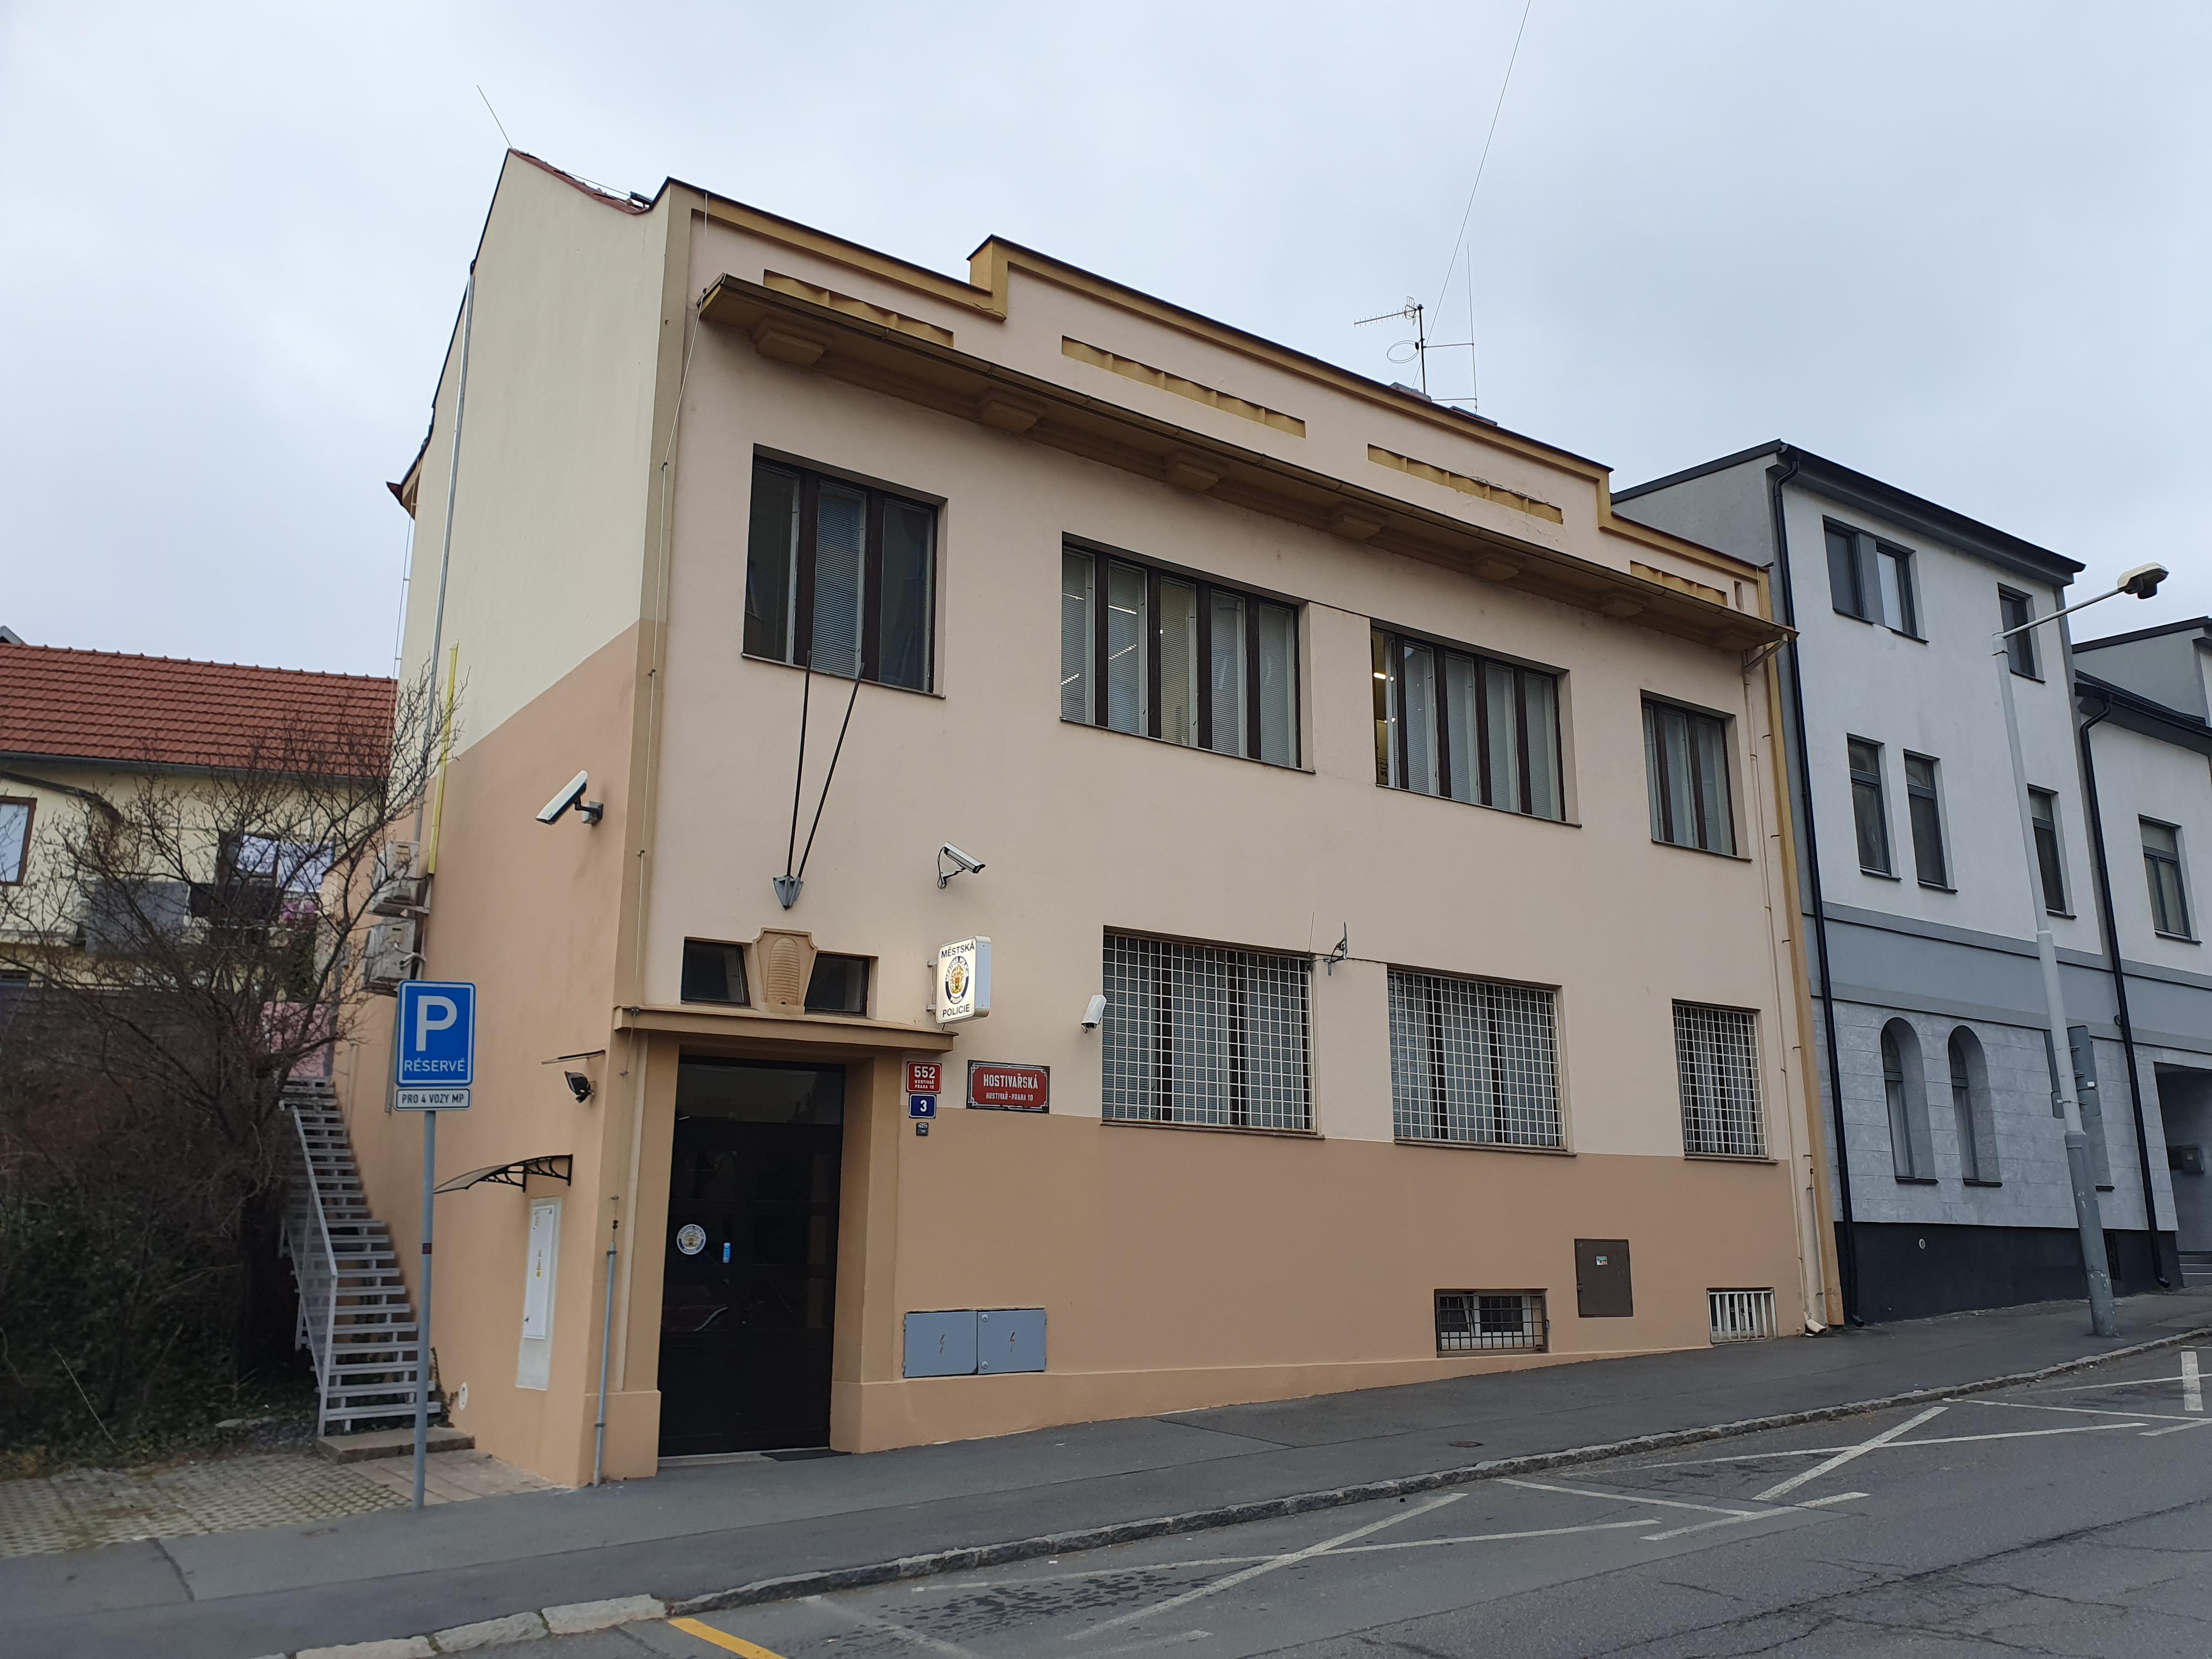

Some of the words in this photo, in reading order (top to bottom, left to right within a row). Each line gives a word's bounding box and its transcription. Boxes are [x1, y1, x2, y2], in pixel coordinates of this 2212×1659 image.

[941, 940, 974, 958] MĚSTSKÁ
[942, 1004, 970, 1018] POLICIE
[416, 995, 457, 1051] P
[404, 1057, 466, 1072] RÉSERVÉ
[914, 1066, 936, 1079] 552
[983, 1073, 1038, 1089] HOSTIVAŘSKÁ
[401, 1094, 419, 1104] PRO
[421, 1094, 426, 1103] 4
[429, 1094, 449, 1103] VOZY
[452, 1093, 465, 1103] MP
[920, 1099, 927, 1112] 3
